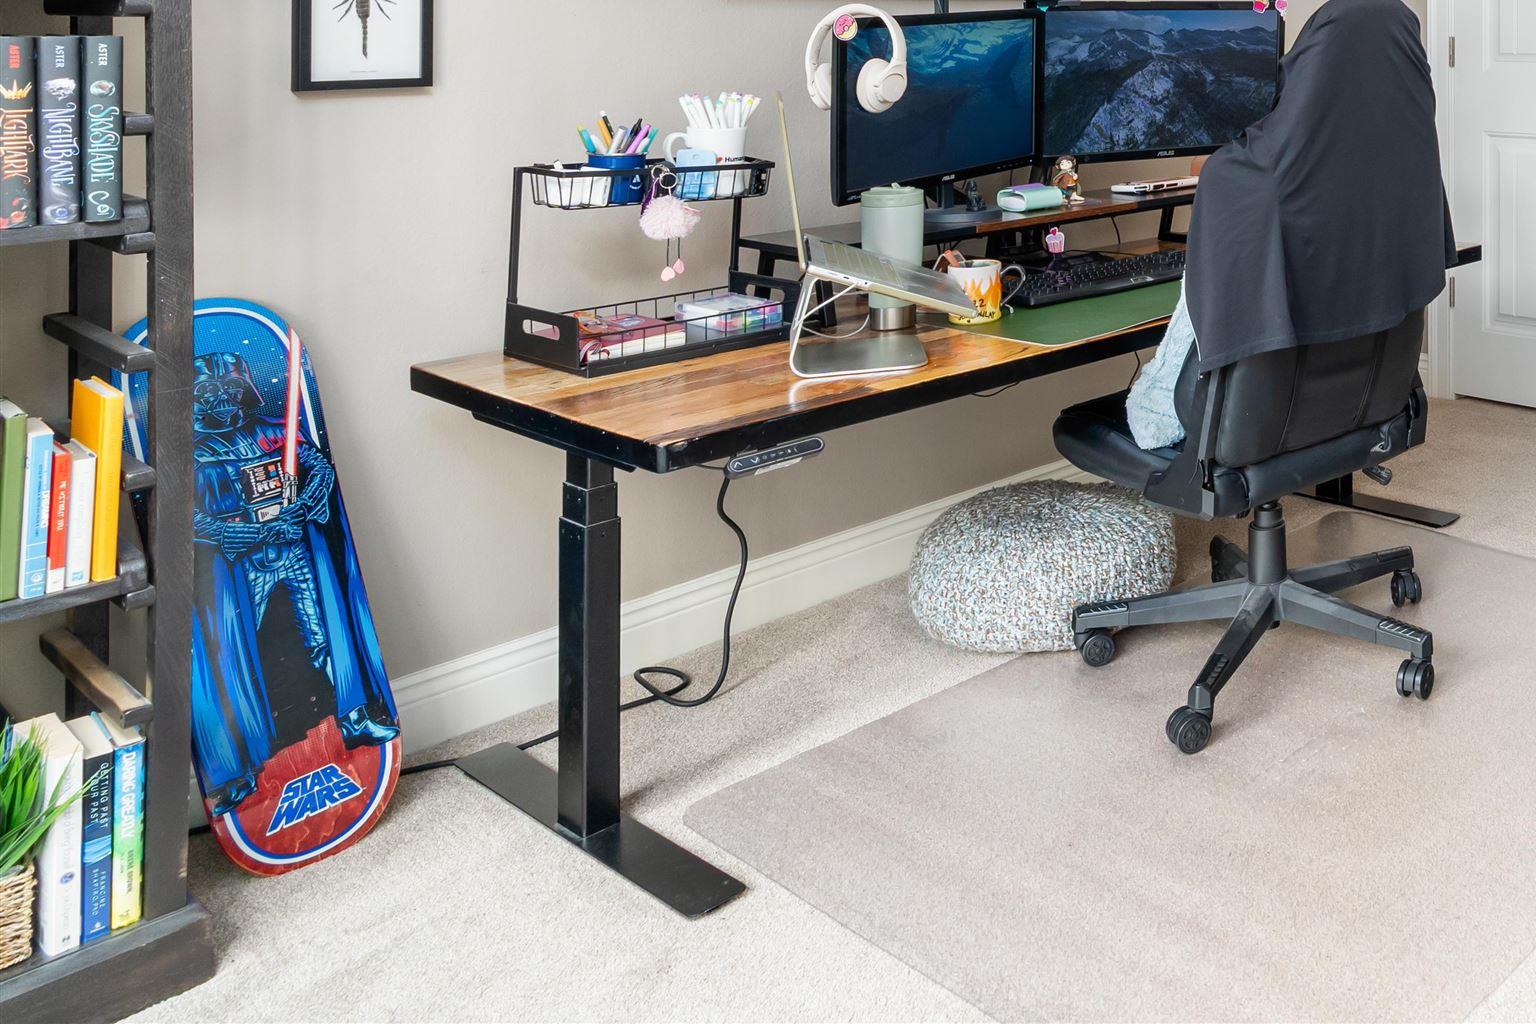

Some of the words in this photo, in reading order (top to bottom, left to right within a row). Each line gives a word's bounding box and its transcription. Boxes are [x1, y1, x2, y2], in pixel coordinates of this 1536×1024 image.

[9, 44, 21, 69] ASTER
[55, 45, 65, 68] ASTER
[98, 42, 108, 66] ASTER
[0, 107, 35, 185] LIGHTLARK
[41, 102, 80, 186] NIGHTBANE
[122, 751, 137, 793] DARING
[281, 763, 346, 805] STAR
[90, 801, 99, 824] PAST
[100, 806, 109, 828] PAST
[120, 792, 136, 838] GREATLY
[265, 775, 363, 837] WARS
